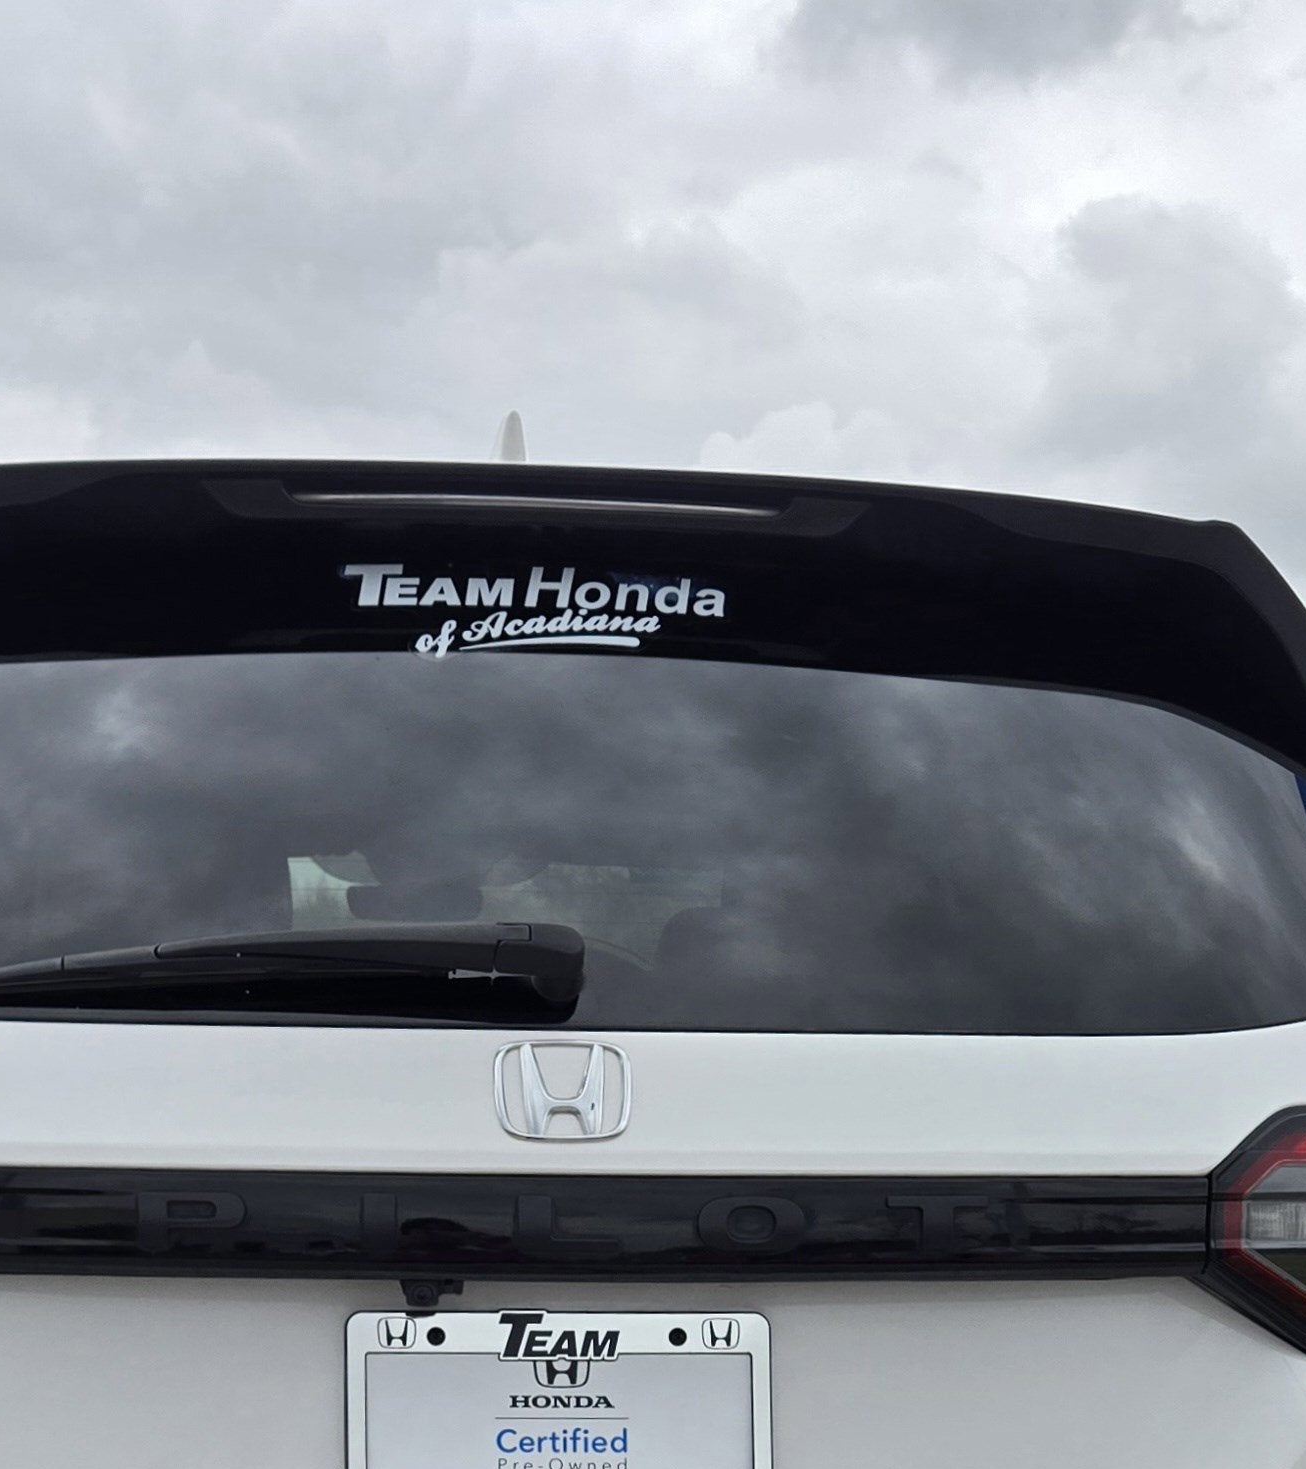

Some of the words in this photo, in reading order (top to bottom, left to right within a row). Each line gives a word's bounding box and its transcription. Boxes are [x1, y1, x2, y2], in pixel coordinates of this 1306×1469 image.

[524, 566, 726, 618] Honda
[414, 620, 457, 658] of
[462, 608, 662, 643] Acadiana
[137, 1191, 990, 1256] PILOT
[509, 1394, 614, 1409] HONDA
[495, 1428, 628, 1454] Certified
